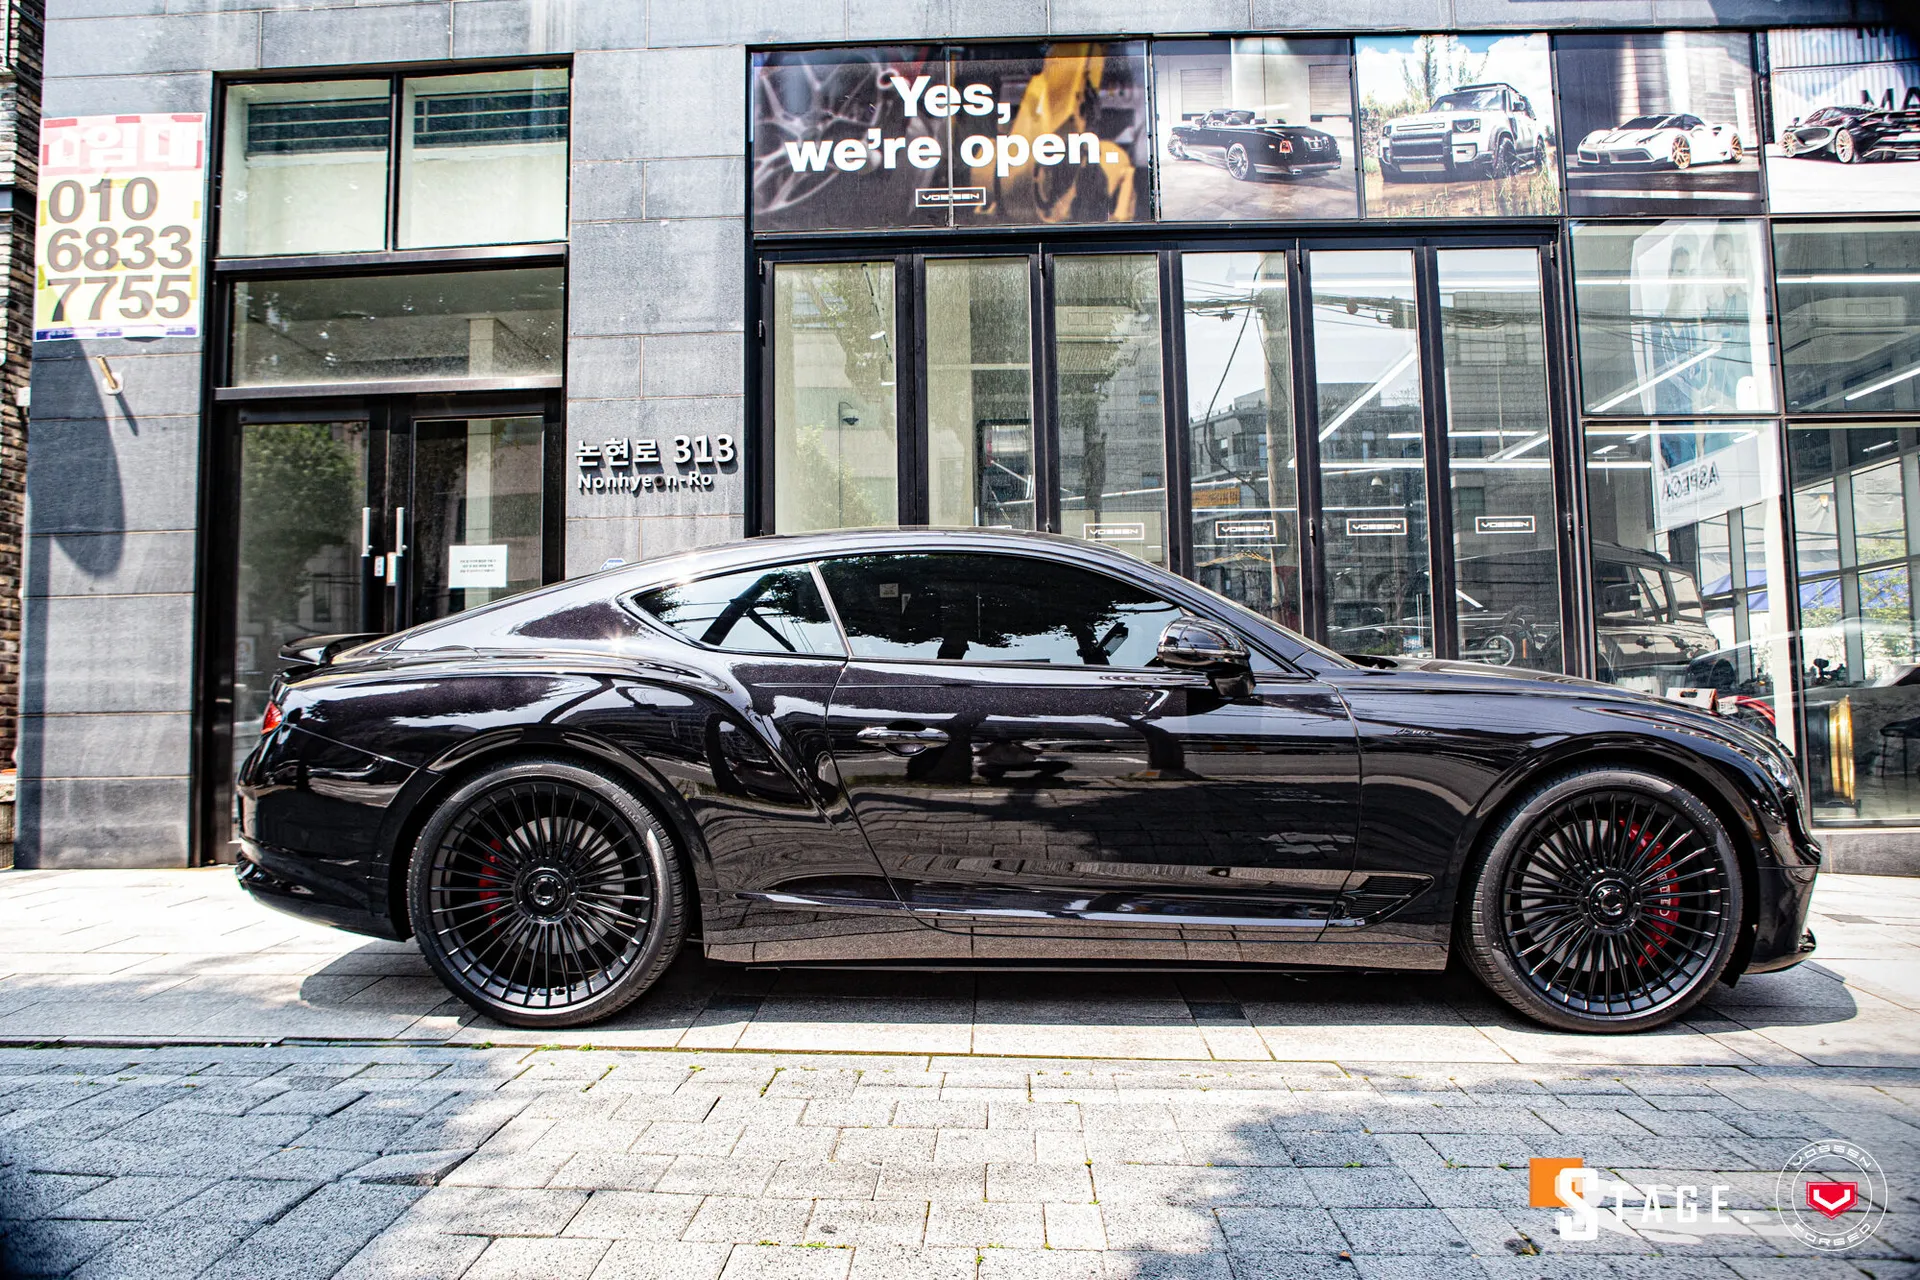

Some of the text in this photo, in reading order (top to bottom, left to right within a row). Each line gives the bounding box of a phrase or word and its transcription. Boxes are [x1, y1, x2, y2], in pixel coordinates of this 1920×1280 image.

[890, 75, 1012, 124] Yes,
[784, 128, 1119, 178] we're open.
[48, 176, 159, 224] 010
[47, 225, 193, 273] 6833
[47, 274, 192, 322] 7755
[574, 433, 735, 467] 논현로 313
[577, 470, 713, 492] Nonhyeon-Ro
